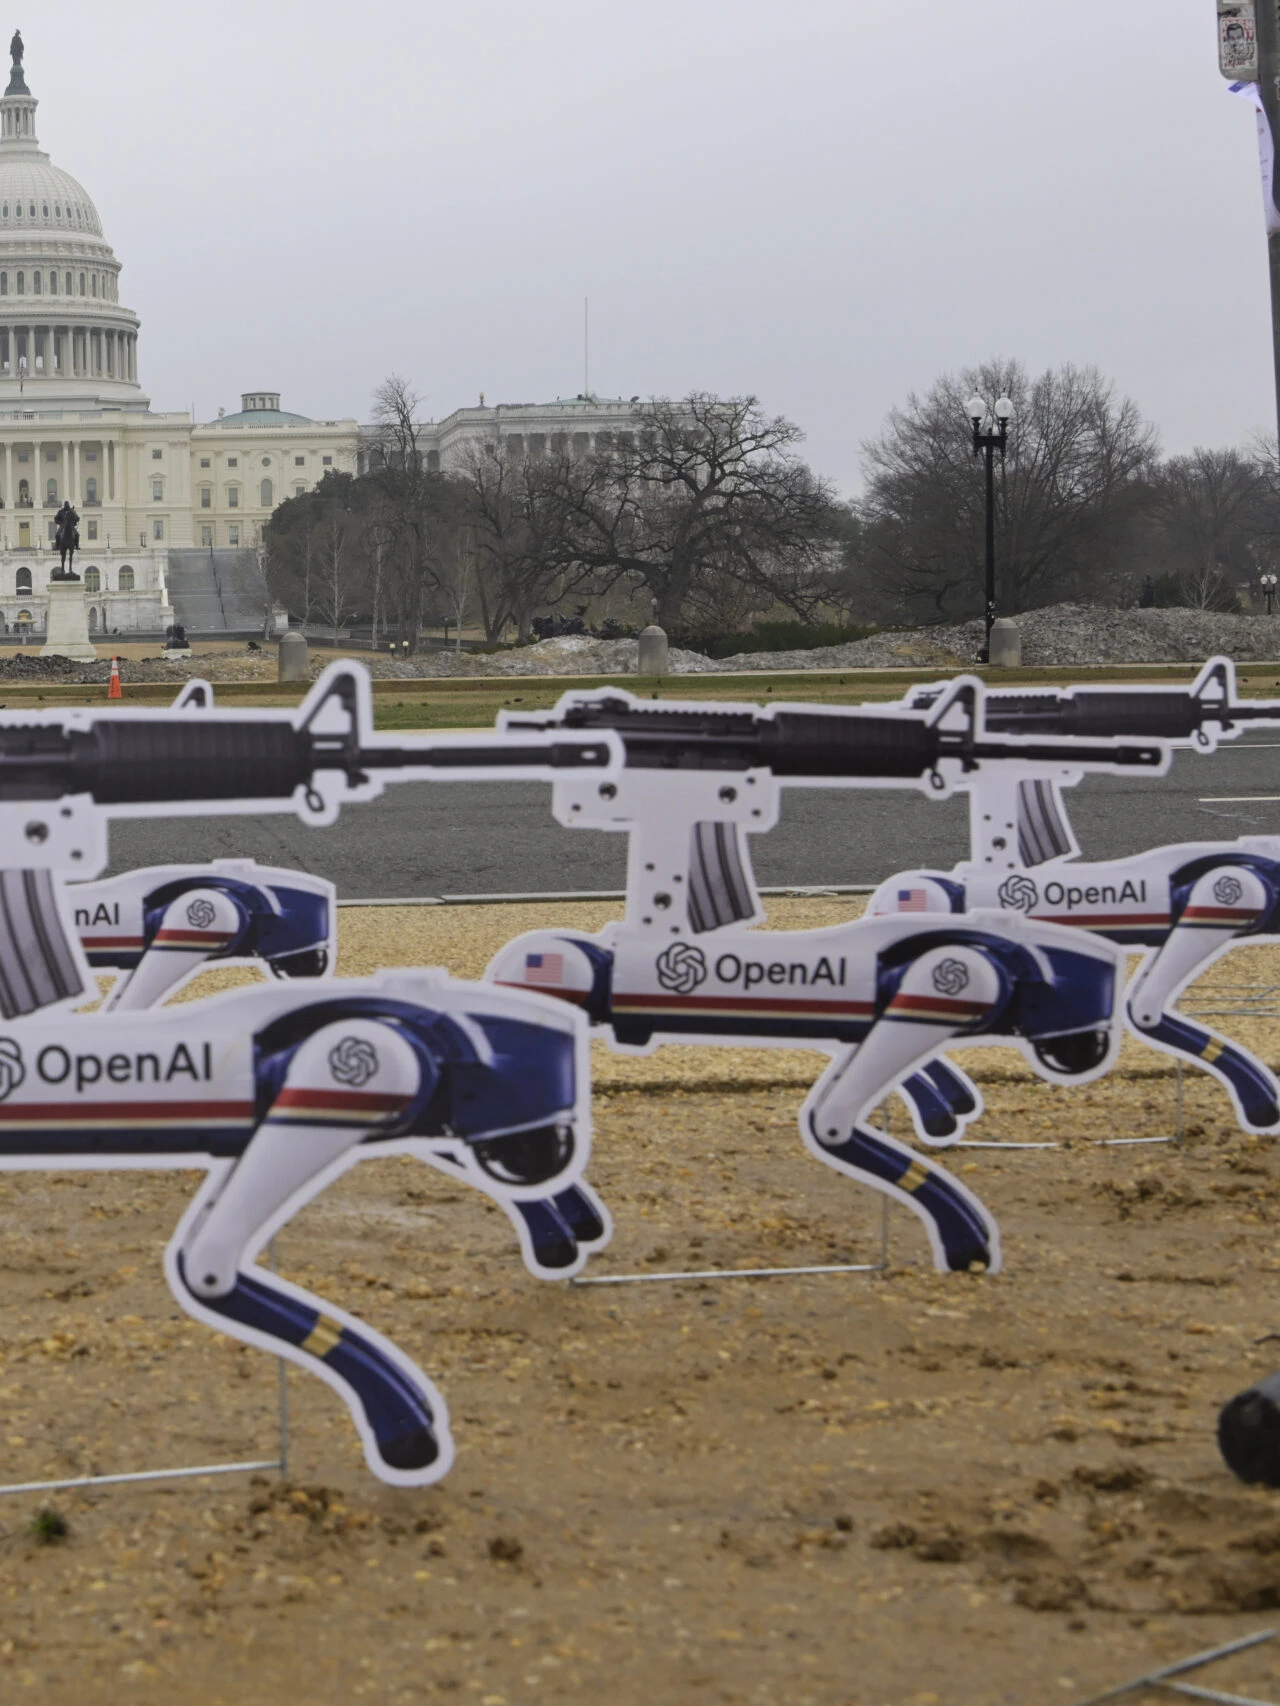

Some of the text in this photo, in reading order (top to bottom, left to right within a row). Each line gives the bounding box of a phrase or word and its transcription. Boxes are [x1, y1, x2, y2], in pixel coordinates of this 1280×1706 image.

[1042, 880, 1147, 910] OpenAI
[75, 903, 120, 926] nAI
[715, 953, 847, 991] OpenAI
[36, 1042, 213, 1093] OpenAI
